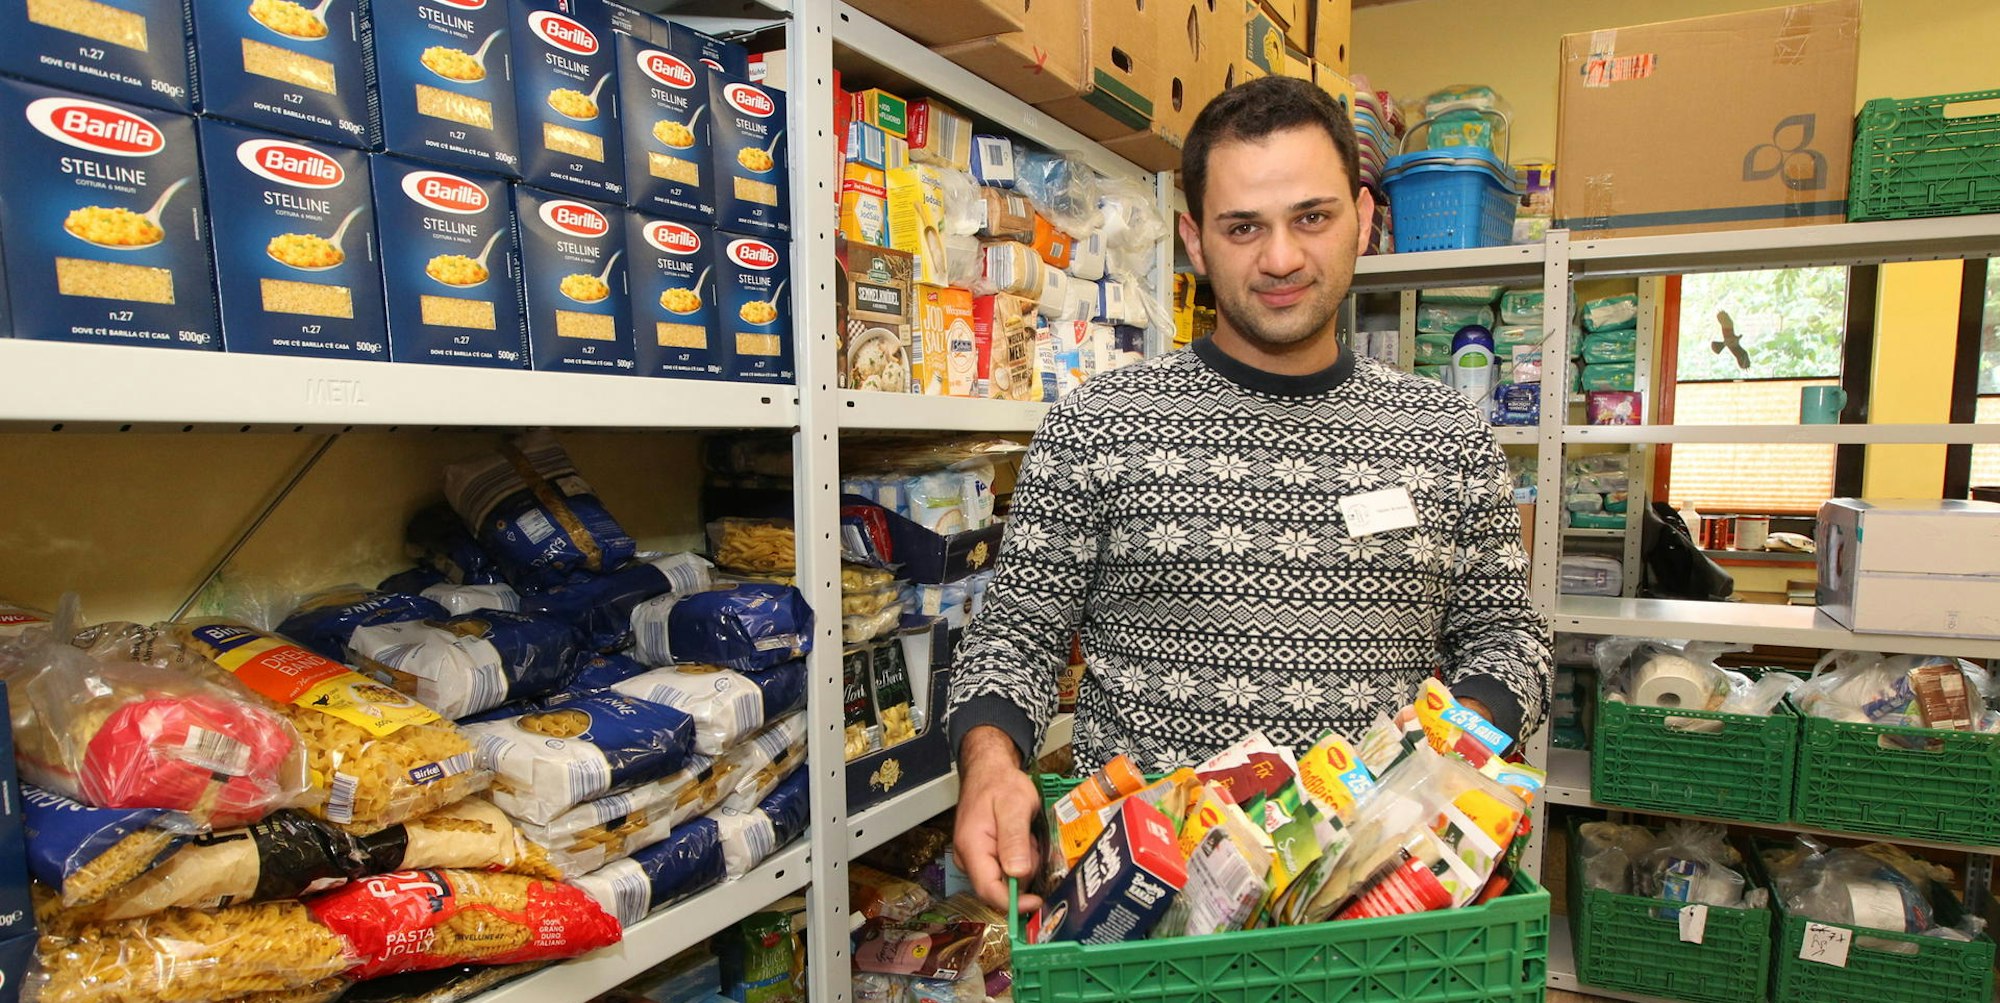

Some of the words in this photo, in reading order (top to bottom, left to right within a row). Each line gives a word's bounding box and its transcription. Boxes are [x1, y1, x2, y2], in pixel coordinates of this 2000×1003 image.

[418, 6, 475, 33] STELLINE
[546, 20, 593, 49] Barilla
[79, 47, 104, 61] n.27
[40, 55, 64, 67] DOVE
[78, 63, 107, 78] BARILLA
[122, 75, 142, 87] CASA
[545, 52, 590, 77] STELLINE
[652, 58, 691, 83] Barilla
[283, 92, 304, 105] n.27
[651, 87, 689, 109] STELLINE
[736, 90, 770, 112] Barilla
[62, 110, 154, 148] Barilla
[450, 130, 466, 140] n.27
[735, 117, 768, 135] STELLINE
[61, 156, 147, 186] STELLINE
[264, 149, 336, 180] Barilla
[570, 163, 583, 172] n.27
[263, 190, 331, 215] STELLINE
[424, 180, 482, 206] Barilla
[423, 217, 478, 237] STELLINE
[557, 208, 602, 230] Barilla
[658, 228, 696, 248] Barilla
[557, 240, 600, 258] STELLINE
[740, 246, 774, 263] Barilla
[658, 258, 694, 274] STELLINE
[738, 274, 772, 286] STELLINE
[109, 310, 134, 322] n.27
[72, 326, 93, 336] DOVE
[109, 328, 138, 338] BARILLA
[152, 332, 170, 340] CASA
[302, 324, 322, 334] n.27
[454, 336, 470, 344] n.27
[413, 764, 442, 780] Birkel
[1252, 760, 1274, 780] Fix
[386, 928, 435, 946] PASTA
[539, 925, 564, 934] GRANO
[541, 932, 562, 940] DURO
[378, 939, 435, 962] JOLLY
